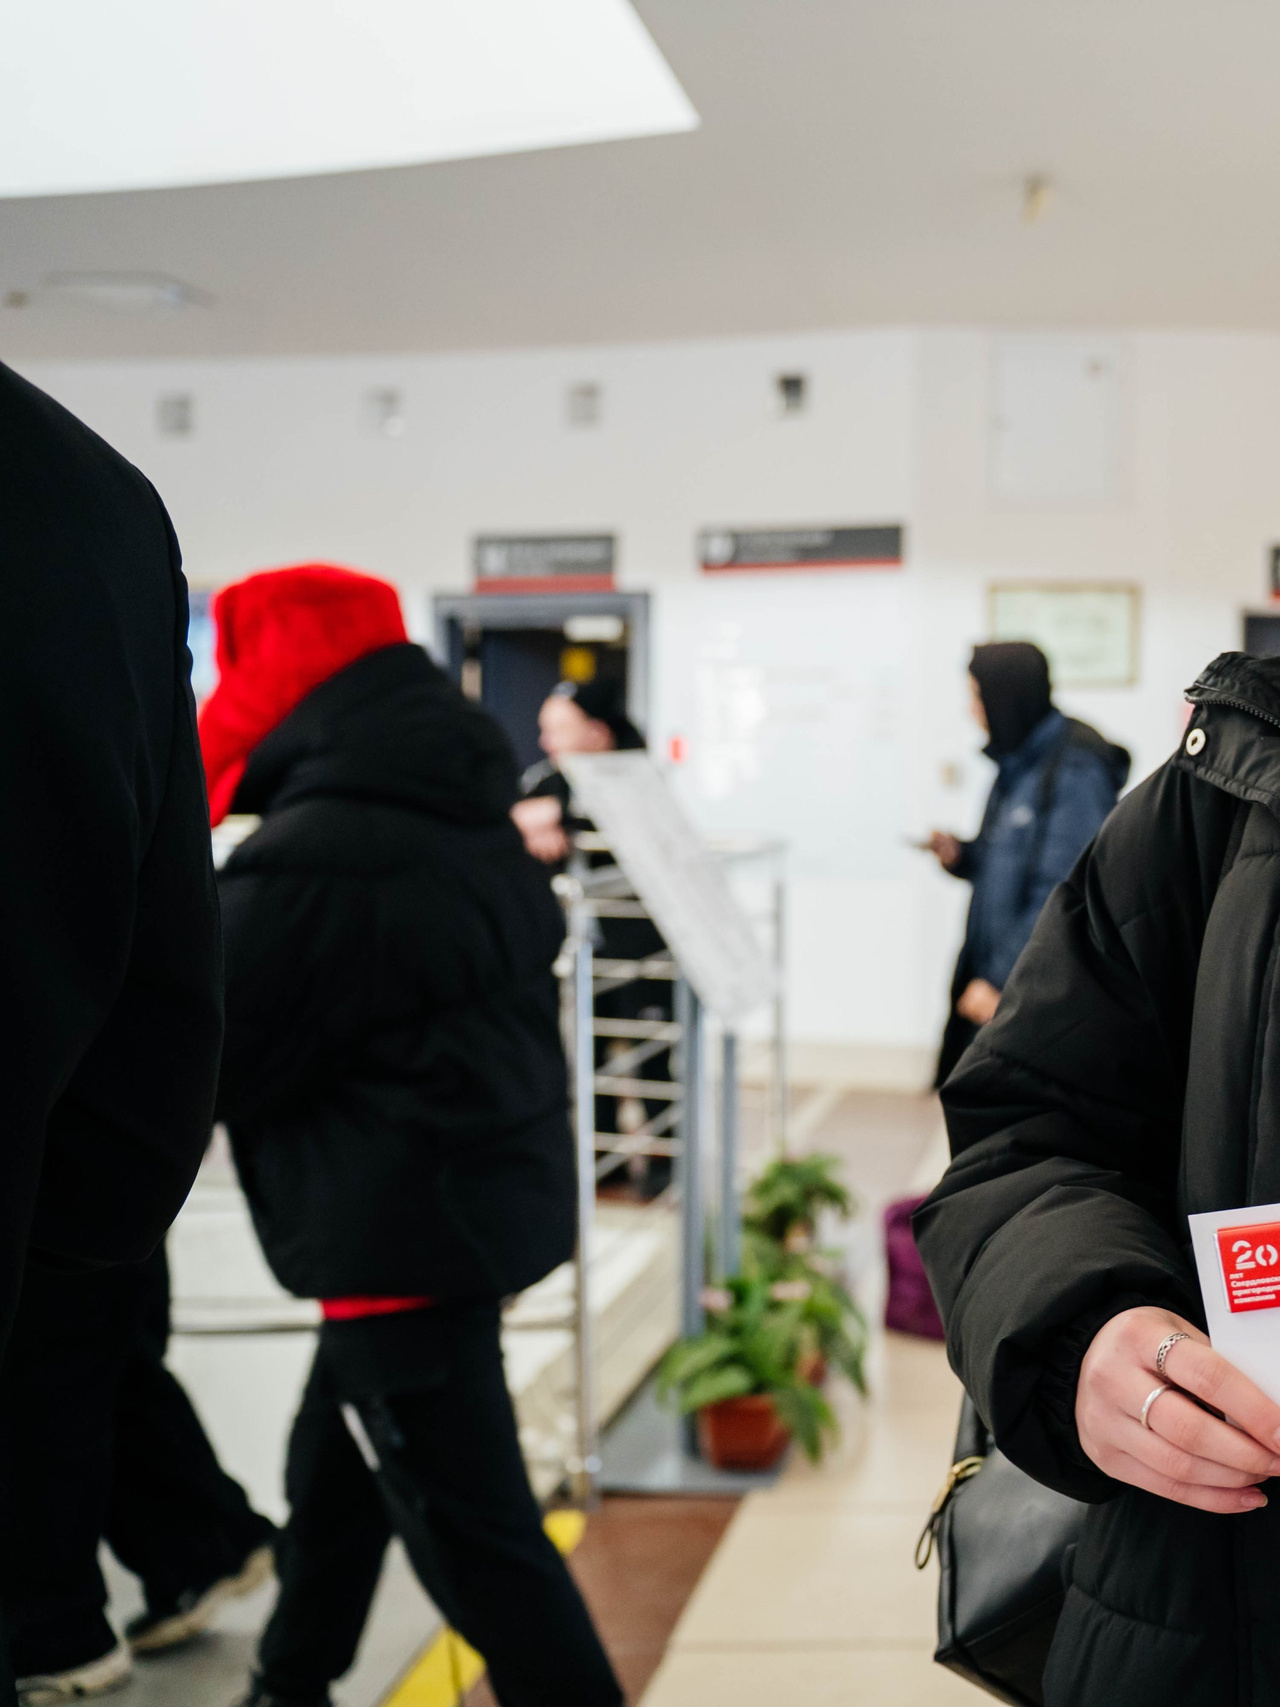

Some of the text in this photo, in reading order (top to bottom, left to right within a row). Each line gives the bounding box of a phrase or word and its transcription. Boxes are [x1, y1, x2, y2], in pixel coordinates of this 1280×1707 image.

[1232, 1240, 1278, 1270] 20
[1229, 1272, 1244, 1280] лет
[1234, 1293, 1276, 1304] компании
